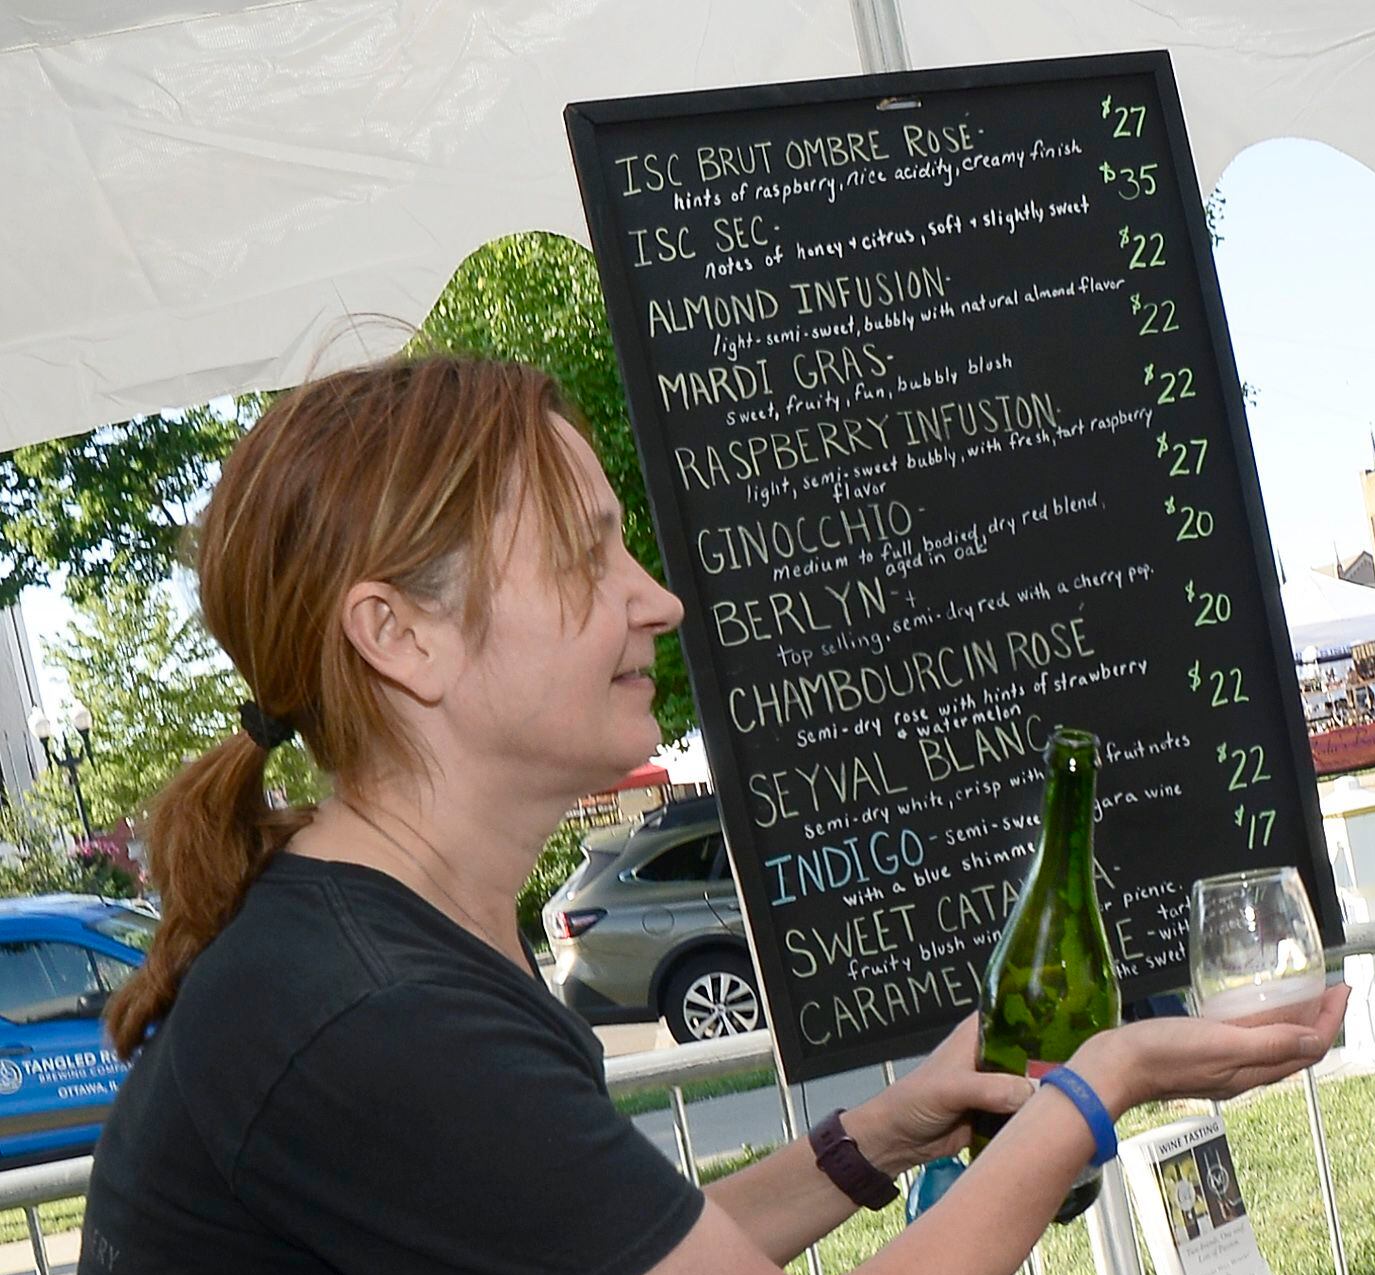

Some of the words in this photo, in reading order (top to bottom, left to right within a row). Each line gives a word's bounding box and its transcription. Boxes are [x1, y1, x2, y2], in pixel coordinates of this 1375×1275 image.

[1101, 95, 1146, 137] $27
[615, 153, 682, 197] ISC
[697, 141, 772, 182] BRUT
[786, 129, 889, 170] OMBRE
[673, 192, 721, 211] hints
[731, 183, 749, 202] of
[755, 174, 844, 204] raspberry,
[846, 163, 886, 187] nice
[895, 162, 960, 187] acidity,
[962, 149, 1024, 172] creamy
[1029, 138, 1082, 161] finish
[1099, 161, 1158, 200] $35
[628, 227, 696, 268] ISC
[704, 258, 753, 280] notes
[765, 250, 783, 267] of
[796, 239, 844, 260] honey
[928, 214, 962, 236] soft
[982, 200, 1045, 235] slightly
[1050, 194, 1090, 216] sweet
[1119, 225, 1166, 269] $22
[649, 288, 779, 338] ALMOND
[864, 309, 914, 332] bubbly
[920, 303, 954, 323] with
[961, 289, 1019, 314] natural
[1025, 283, 1075, 303] almond
[1078, 275, 1126, 294] flavor
[1130, 292, 1180, 336] $22
[657, 359, 773, 413] MARDI
[726, 402, 780, 426] sweet,
[785, 389, 851, 416] fruity,
[854, 382, 893, 402] fun,
[897, 366, 957, 391] bubbly
[968, 353, 1013, 375] blush
[1144, 362, 1196, 405] $22
[674, 414, 889, 491] RASPBERRY
[746, 476, 798, 509] light,
[802, 455, 898, 491] semi-sweet
[906, 441, 965, 469] bubbly,
[967, 438, 1002, 458] with
[1055, 419, 1085, 441] tart
[1090, 407, 1153, 434] raspberry
[1156, 431, 1209, 477] $27
[832, 481, 887, 504] flavor
[773, 553, 849, 582] medium
[858, 548, 873, 565] to
[880, 539, 913, 564] full
[988, 516, 1016, 536] dry
[1022, 503, 1048, 526] red
[1164, 495, 1215, 542] $20
[885, 552, 923, 579] aged
[929, 548, 946, 566] in
[776, 644, 814, 668] top
[821, 630, 892, 656] selling,
[977, 592, 1011, 614] red
[1017, 581, 1051, 604] with
[1057, 581, 1069, 594] a
[1073, 570, 1123, 595] cherry
[1128, 563, 1154, 583] pop.
[1185, 580, 1233, 628] $20
[728, 639, 999, 734] CHAMBOURCIN
[938, 694, 976, 717] with
[982, 682, 1026, 705] hints
[1033, 671, 1049, 696] of
[1053, 659, 1148, 693] strawberry
[1187, 659, 1250, 708] $22
[1106, 740, 1146, 763] fruit
[1149, 730, 1191, 754] notes
[1216, 742, 1272, 792] $22
[749, 751, 909, 828] SEYVAL
[955, 778, 1002, 800] crisp
[1009, 766, 1046, 788] with
[1144, 783, 1183, 799] wine
[1233, 804, 1276, 850] $17
[843, 887, 885, 908] with
[892, 882, 906, 894] a
[913, 864, 951, 888] blue
[960, 840, 1036, 872] shimme
[785, 903, 916, 979] SWEET
[848, 952, 912, 981] fruity
[918, 937, 966, 961] blush
[972, 928, 1002, 947] win
[1146, 947, 1187, 969] sweet
[21, 1051, 97, 1076] TANGLED
[1158, 1137, 1185, 1156] WINE
[1182, 1120, 1221, 1147] TASTING
